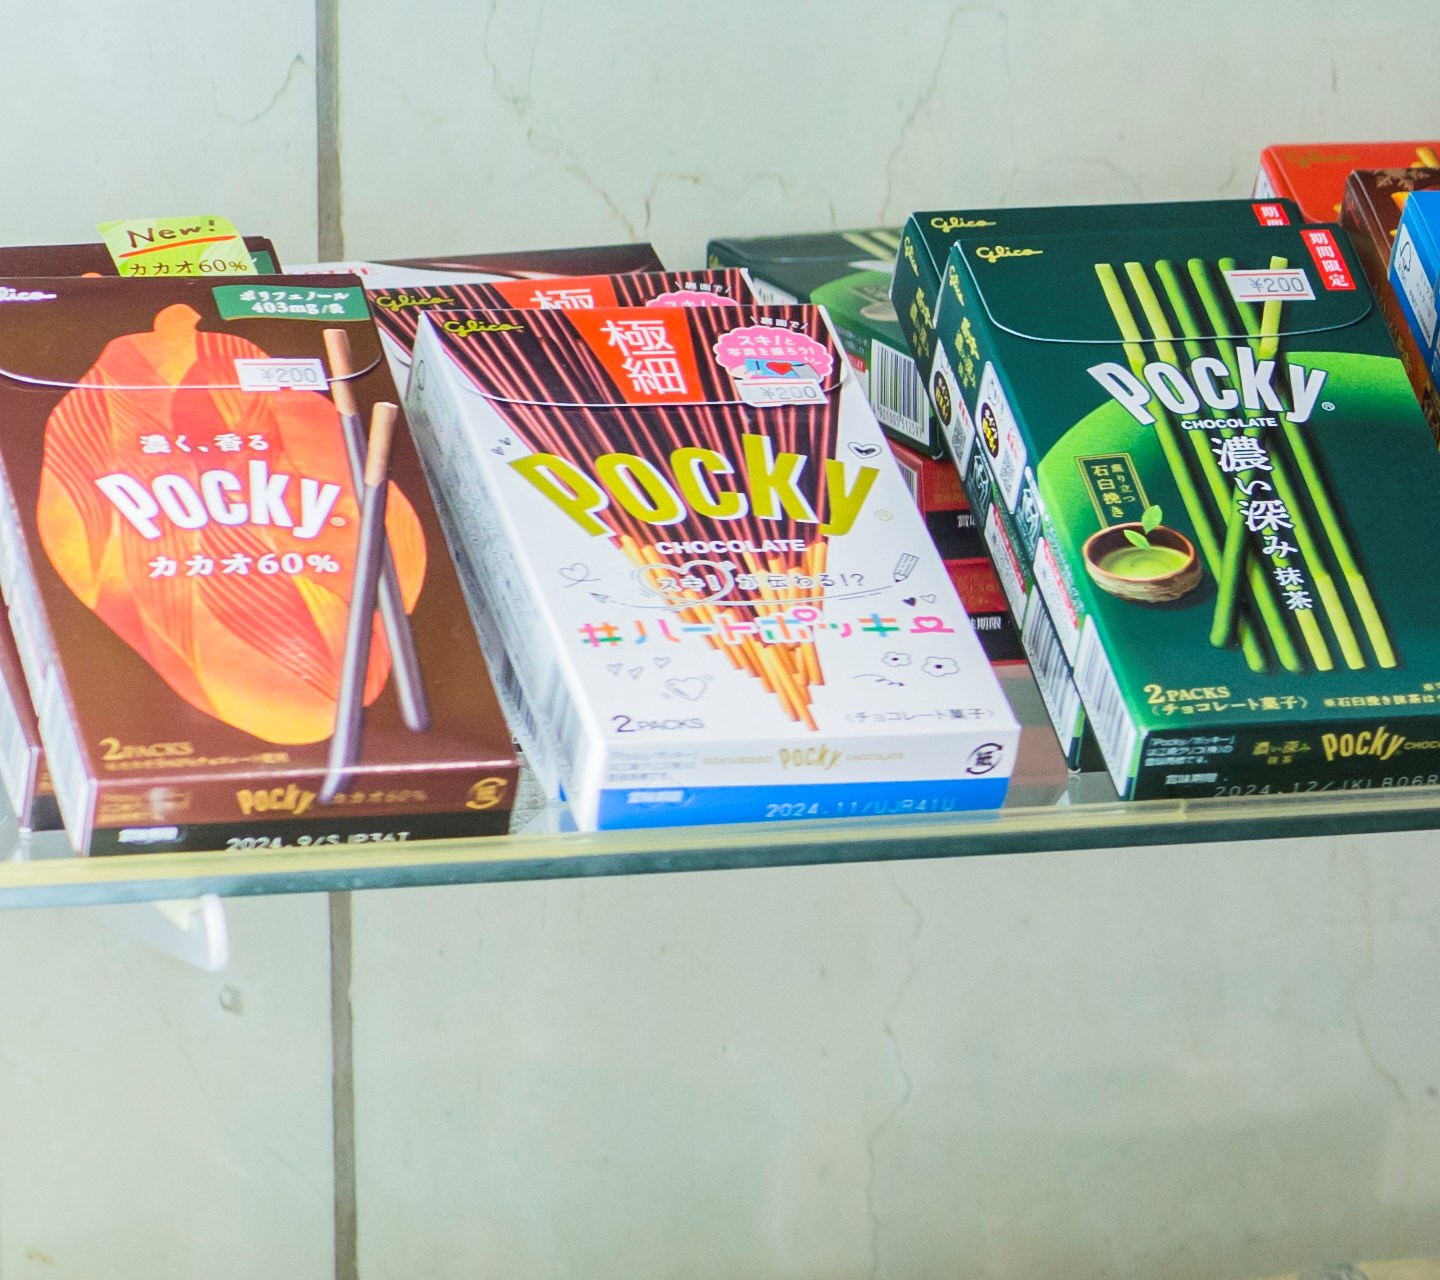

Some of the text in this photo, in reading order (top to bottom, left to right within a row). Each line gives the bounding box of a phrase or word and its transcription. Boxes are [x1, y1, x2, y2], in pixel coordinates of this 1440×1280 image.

[126, 219, 215, 249] New!
[976, 245, 1044, 262] Glico
[1309, 229, 1350, 290] 期間限定
[130, 259, 248, 278] カカオ60%
[1251, 275, 1305, 294] ¥200
[239, 289, 350, 304] ポリフェノール
[601, 319, 688, 396] 極細
[260, 367, 318, 385] ¥200
[759, 385, 817, 402] ¥200
[1181, 417, 1278, 431] CHOCOLATE
[139, 433, 270, 455] 濃く、香る
[656, 539, 807, 555] CHOCOLATE
[147, 553, 341, 580] カカオ60%
